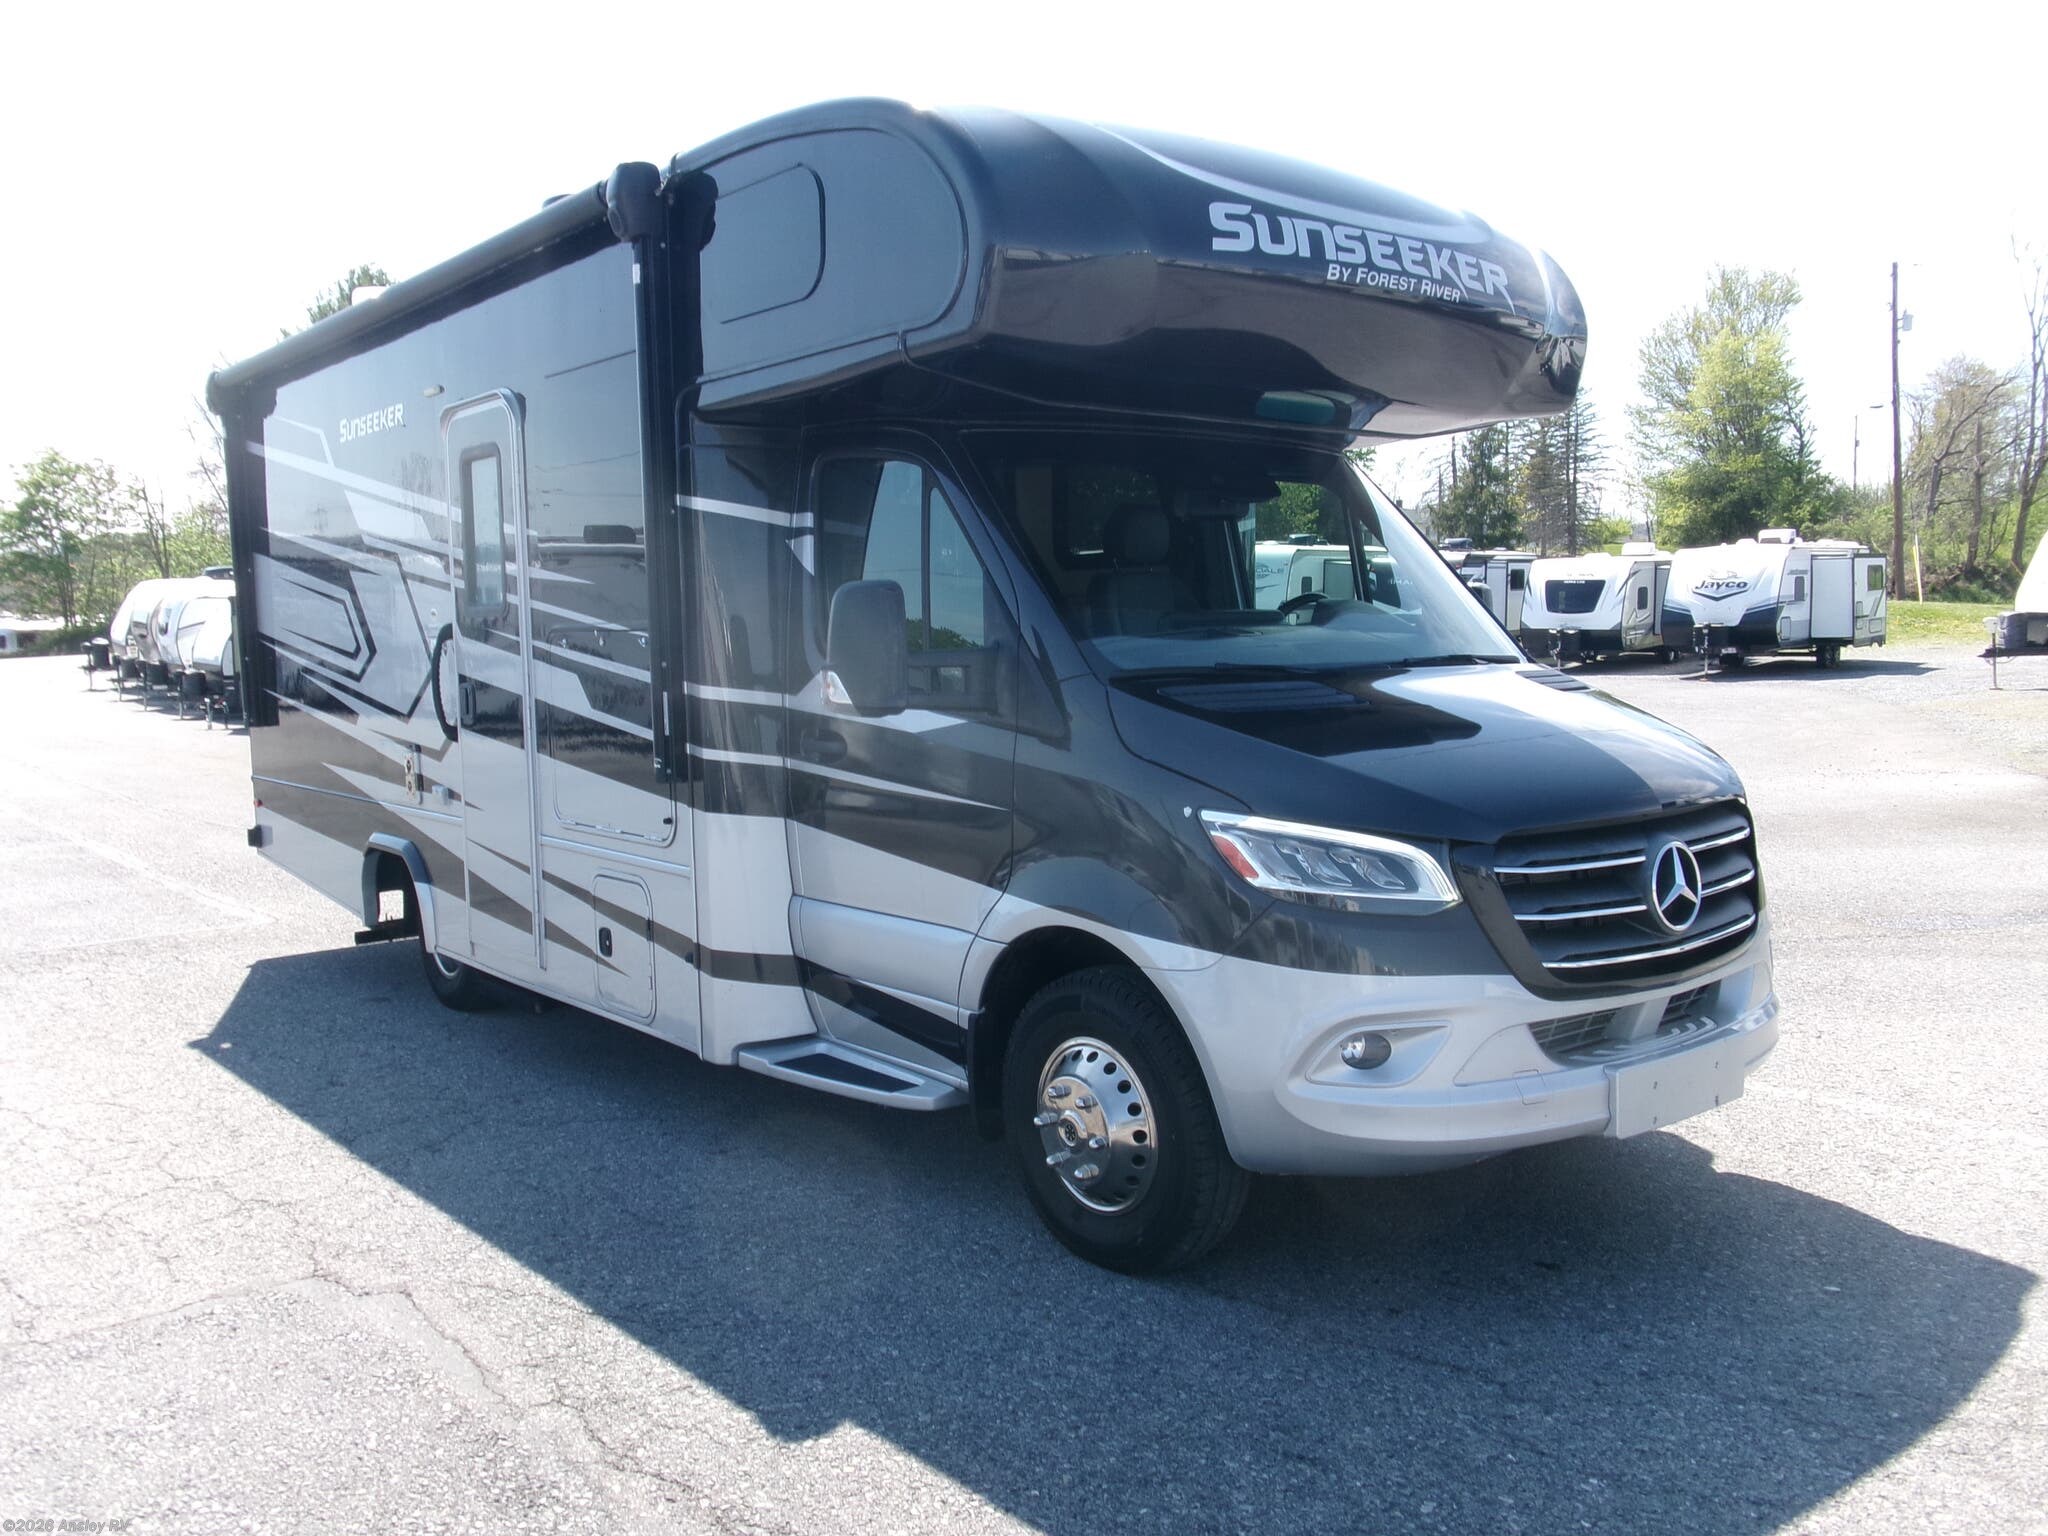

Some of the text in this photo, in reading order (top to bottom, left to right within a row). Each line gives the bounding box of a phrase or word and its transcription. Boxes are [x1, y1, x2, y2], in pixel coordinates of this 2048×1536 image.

[1326, 263, 1462, 303] BY FOREST RIVER
